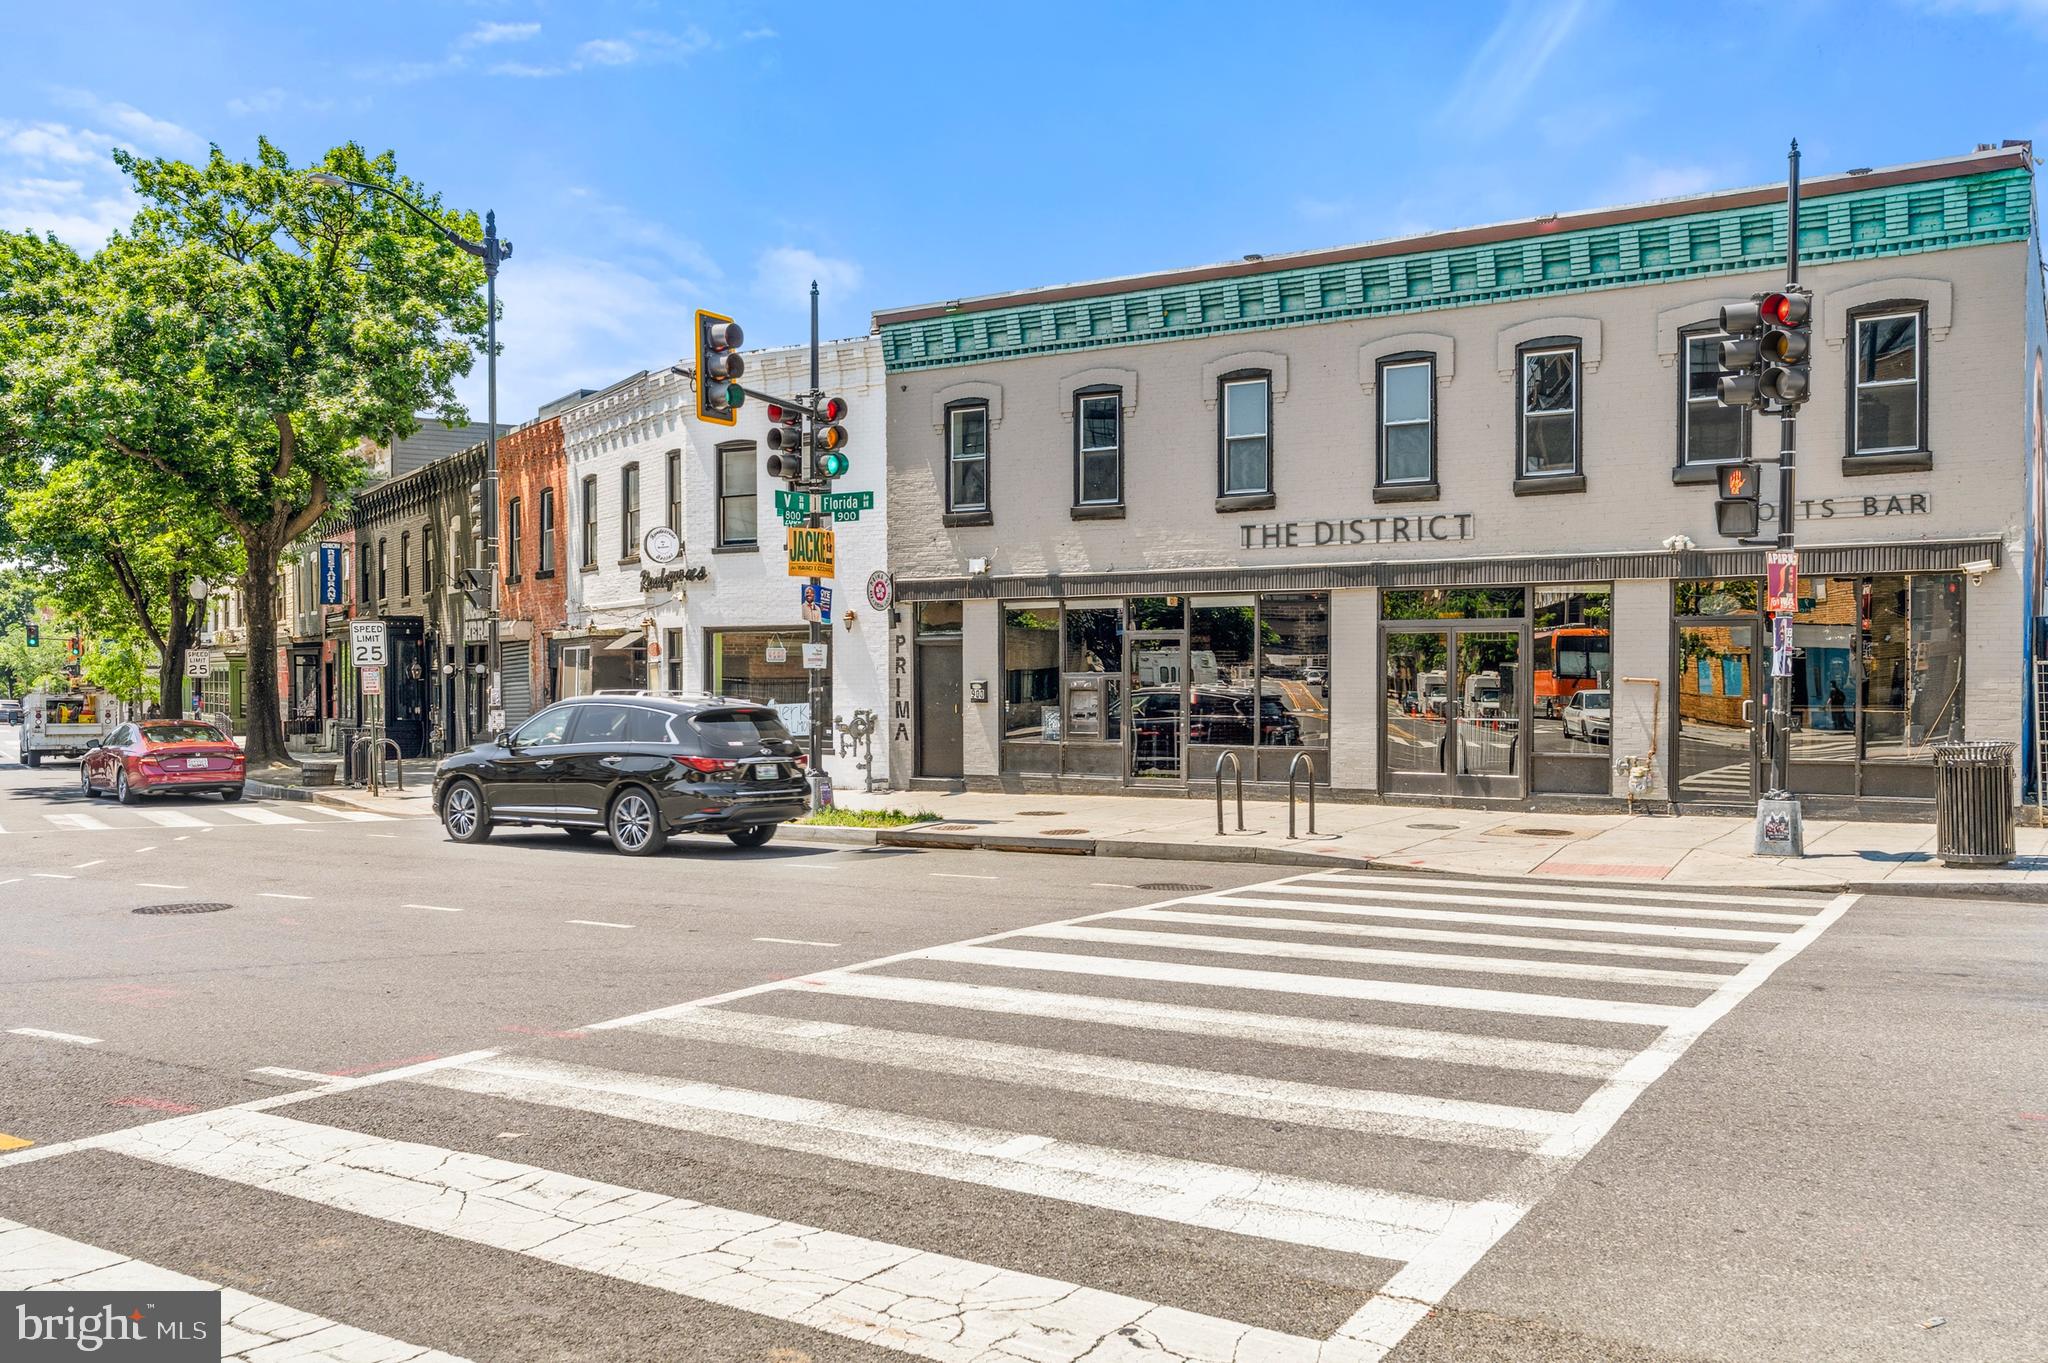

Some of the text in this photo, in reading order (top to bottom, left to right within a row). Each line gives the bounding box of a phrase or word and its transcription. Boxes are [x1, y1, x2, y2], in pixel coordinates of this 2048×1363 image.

[784, 493, 792, 508] V
[823, 495, 858, 511] Florida
[1863, 494, 1927, 516] BAR
[785, 510, 801, 521] 800
[837, 511, 857, 521] 900
[1240, 514, 1472, 549] THE DISTRICT
[326, 549, 337, 603] RESTAURANT
[353, 625, 383, 633] SPEED
[356, 635, 380, 643] LIMIT
[356, 646, 383, 661] 25
[189, 664, 208, 675] 25
[895, 634, 910, 741] PRIMA
